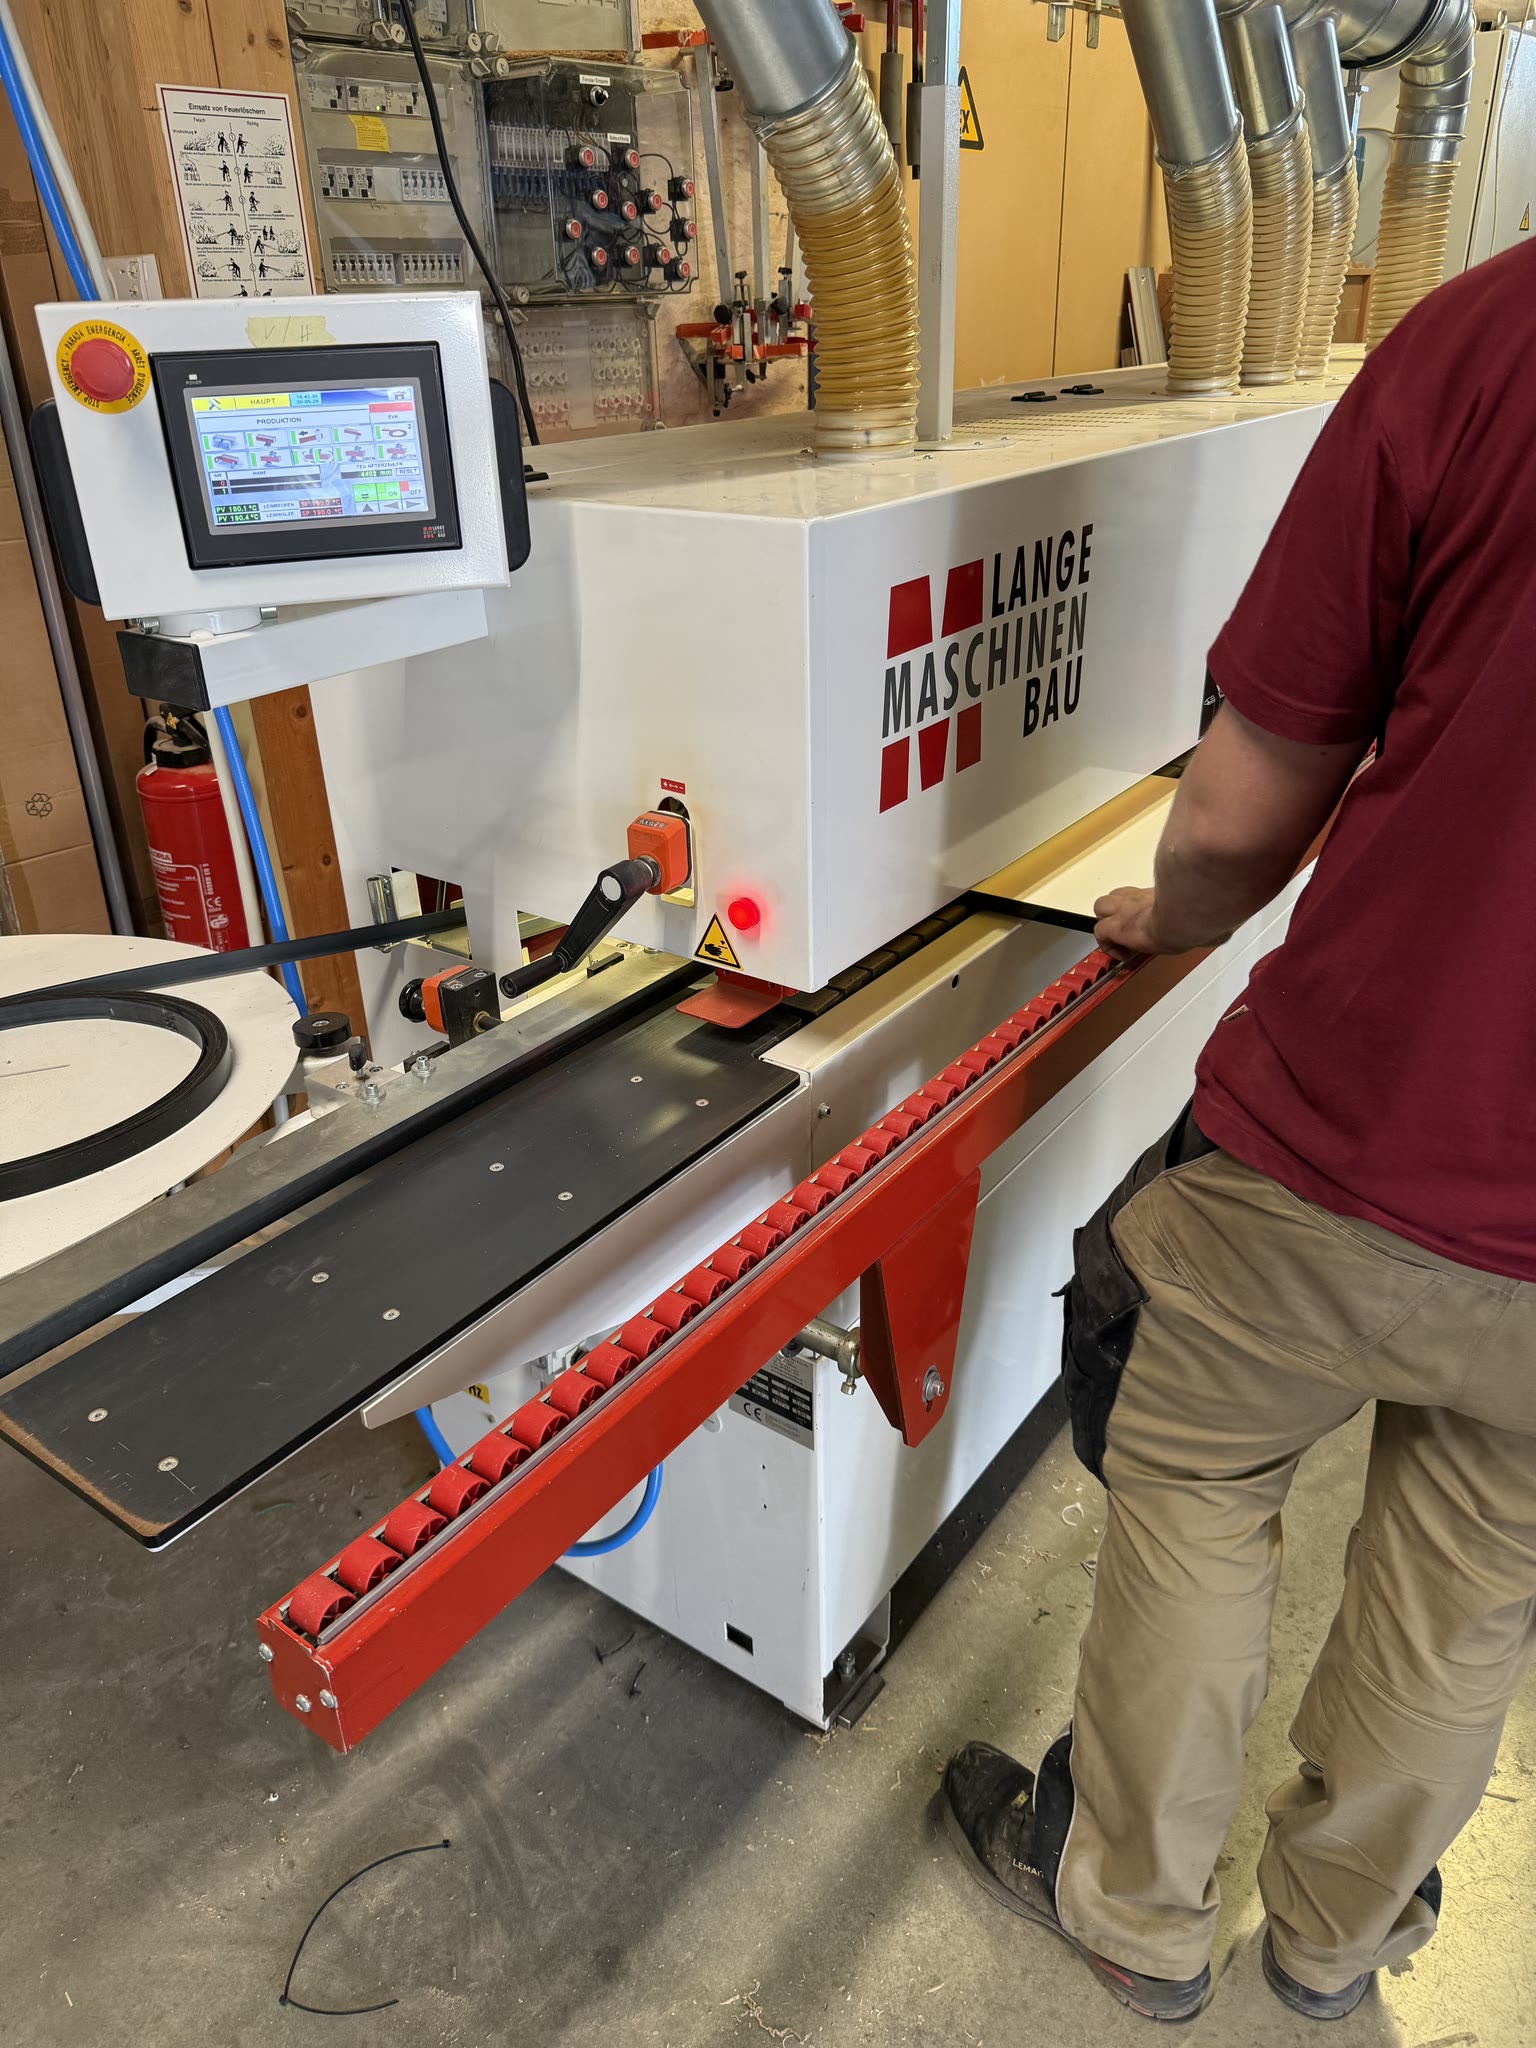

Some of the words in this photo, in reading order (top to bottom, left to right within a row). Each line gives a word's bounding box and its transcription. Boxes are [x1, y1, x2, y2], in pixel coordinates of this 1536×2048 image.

[188, 103, 211, 111] Einsatz
[224, 106, 266, 115] Feuerlöschern
[64, 330, 84, 350] PARADA
[86, 325, 126, 344] EMERGENCIA
[61, 358, 81, 396] EMERGENCY
[84, 395, 100, 408] STOP
[230, 514, 249, 522] 190.4
[992, 523, 1093, 618] LANGE
[882, 592, 1088, 739] MASCHINEN
[1023, 655, 1083, 738] BAU
[744, 1403, 762, 1421] CE
